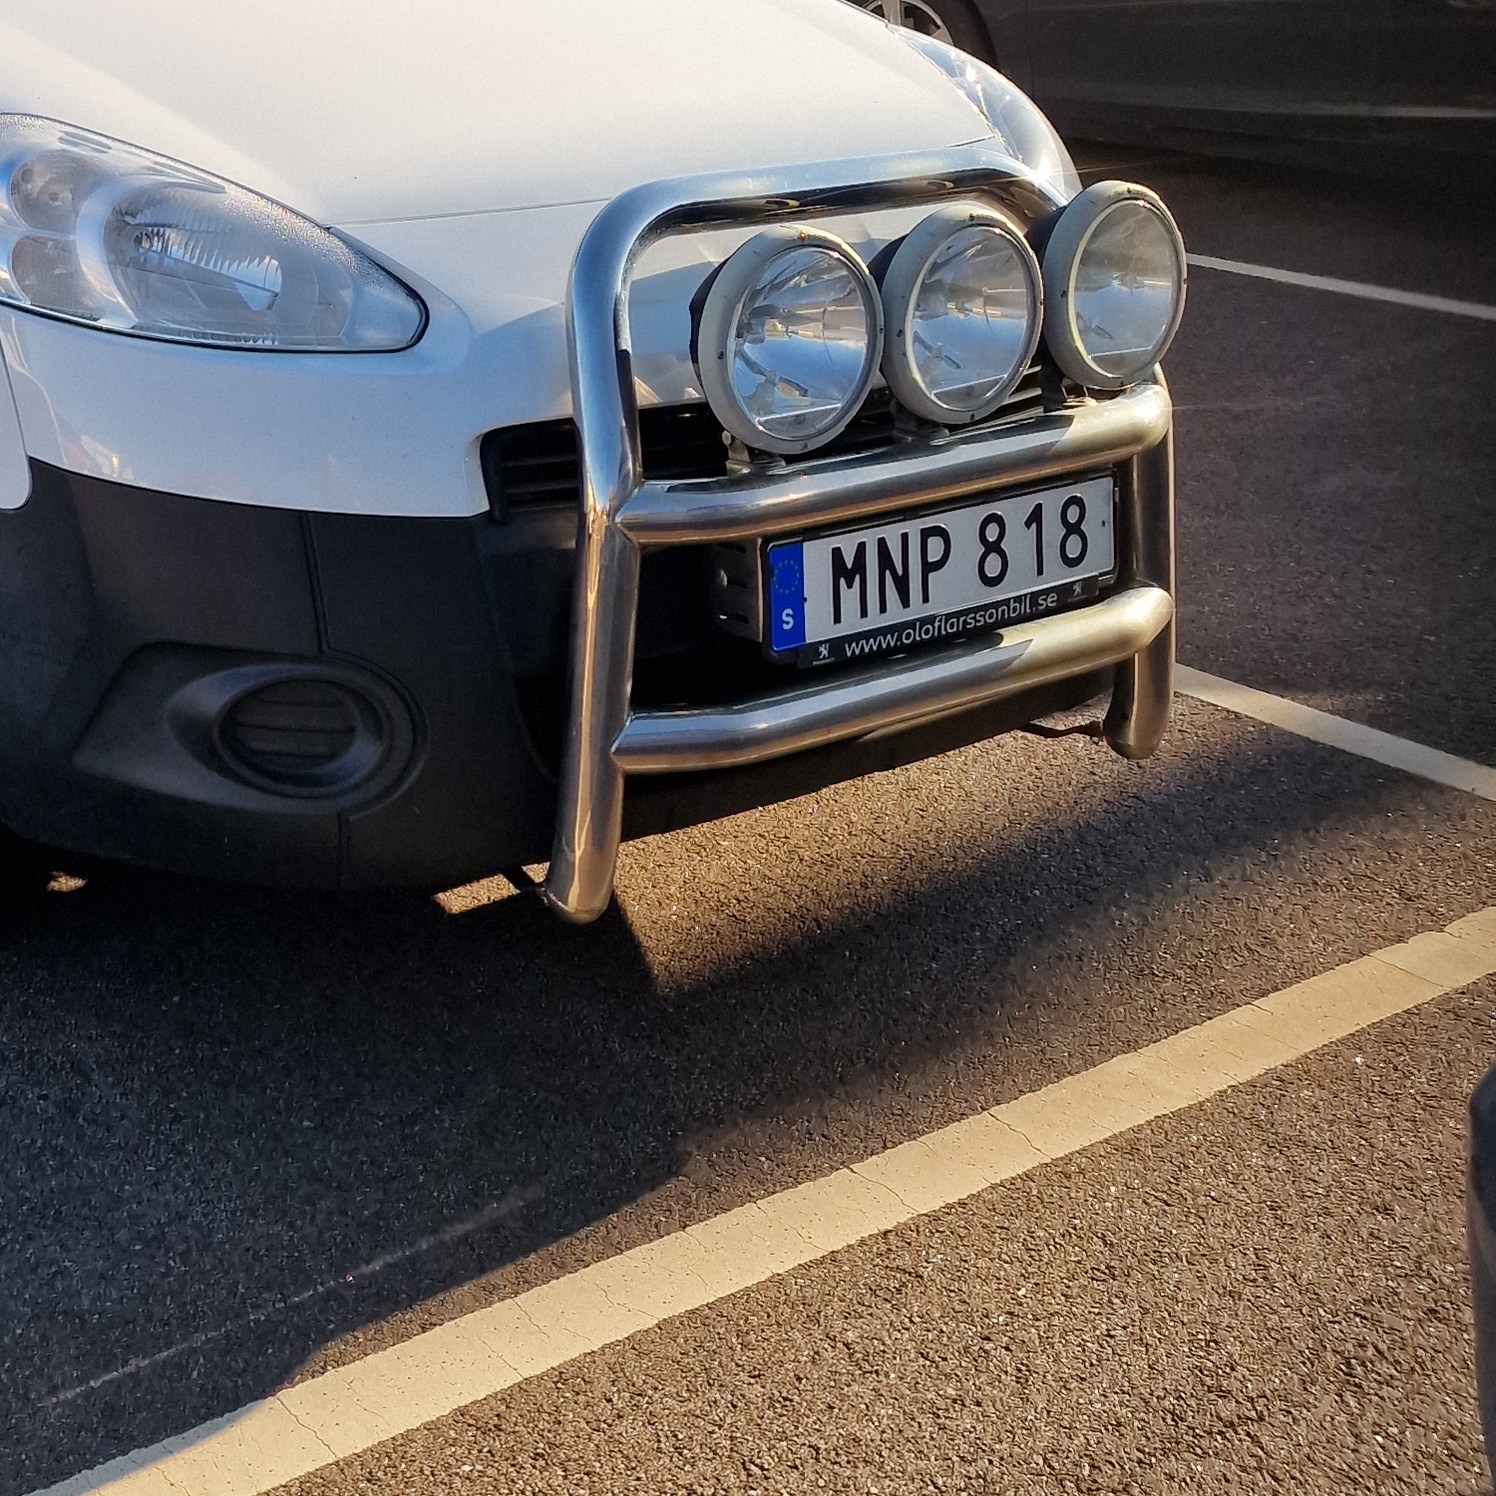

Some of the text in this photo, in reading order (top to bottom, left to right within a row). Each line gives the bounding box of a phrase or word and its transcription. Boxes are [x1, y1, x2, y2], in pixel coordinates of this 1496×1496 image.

[830, 494, 1089, 626] MNP 818
[780, 608, 795, 631] S
[844, 592, 1059, 659] www.oloflarssonbil.se
